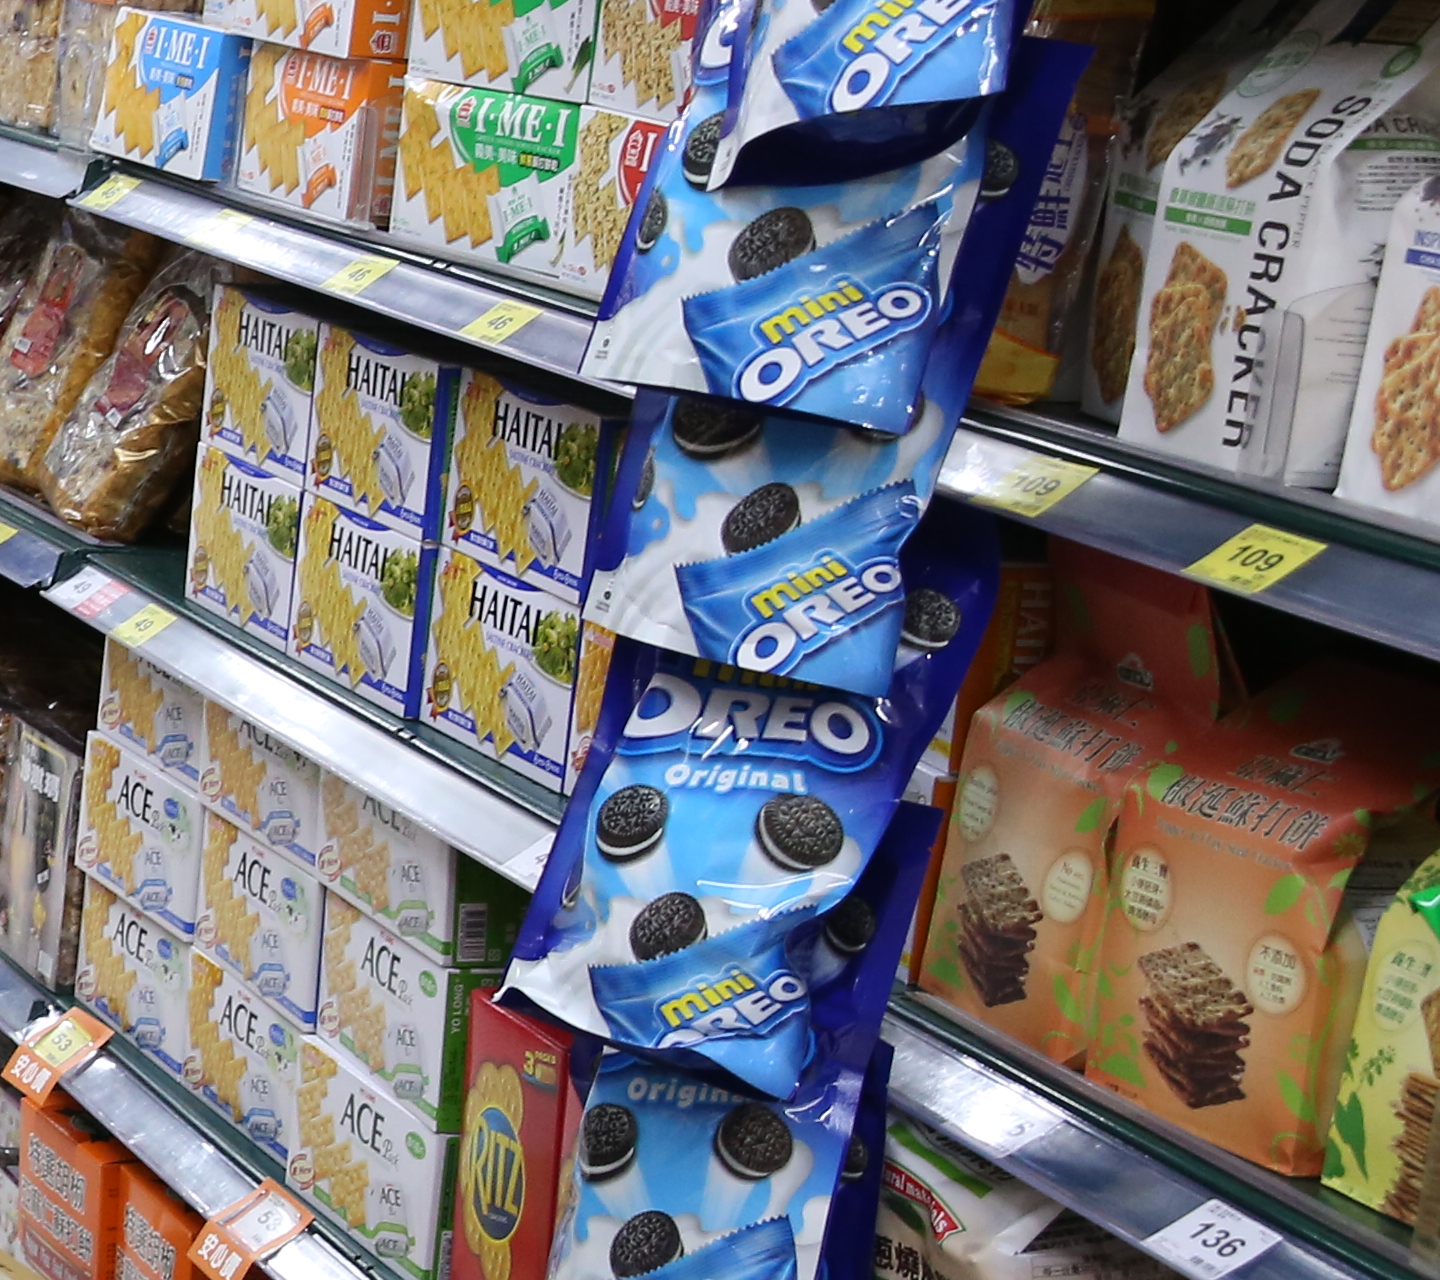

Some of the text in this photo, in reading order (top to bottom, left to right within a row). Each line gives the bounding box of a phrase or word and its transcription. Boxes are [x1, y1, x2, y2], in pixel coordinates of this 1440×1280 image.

[474, 96, 567, 147] I·ME·I
[1221, 94, 1373, 451] SODA CRACKER
[238, 308, 289, 361] HAITAI
[488, 311, 516, 332] 46
[761, 284, 860, 347] mini
[737, 284, 929, 408] OREO
[347, 353, 405, 407] HAITAI
[493, 400, 562, 461] HAITAI
[221, 471, 273, 523] HAITAI
[1014, 475, 1059, 496] 109
[328, 523, 388, 581] HAITAI
[1227, 545, 1285, 571] 109
[469, 581, 541, 645] HAITAI
[751, 557, 847, 620] mini
[133, 616, 153, 634] 49
[733, 557, 901, 679] OREO
[622, 675, 874, 753] OREO
[118, 775, 153, 823] ACE
[665, 762, 805, 793] Original
[235, 852, 271, 900] ACE
[113, 913, 146, 961] ACE
[361, 938, 401, 991] ACE
[219, 995, 258, 1044] ACE
[655, 971, 808, 1049] OREO
[659, 971, 755, 1029] mini
[340, 1094, 384, 1153] ACE
[1187, 1223, 1244, 1258] 136
